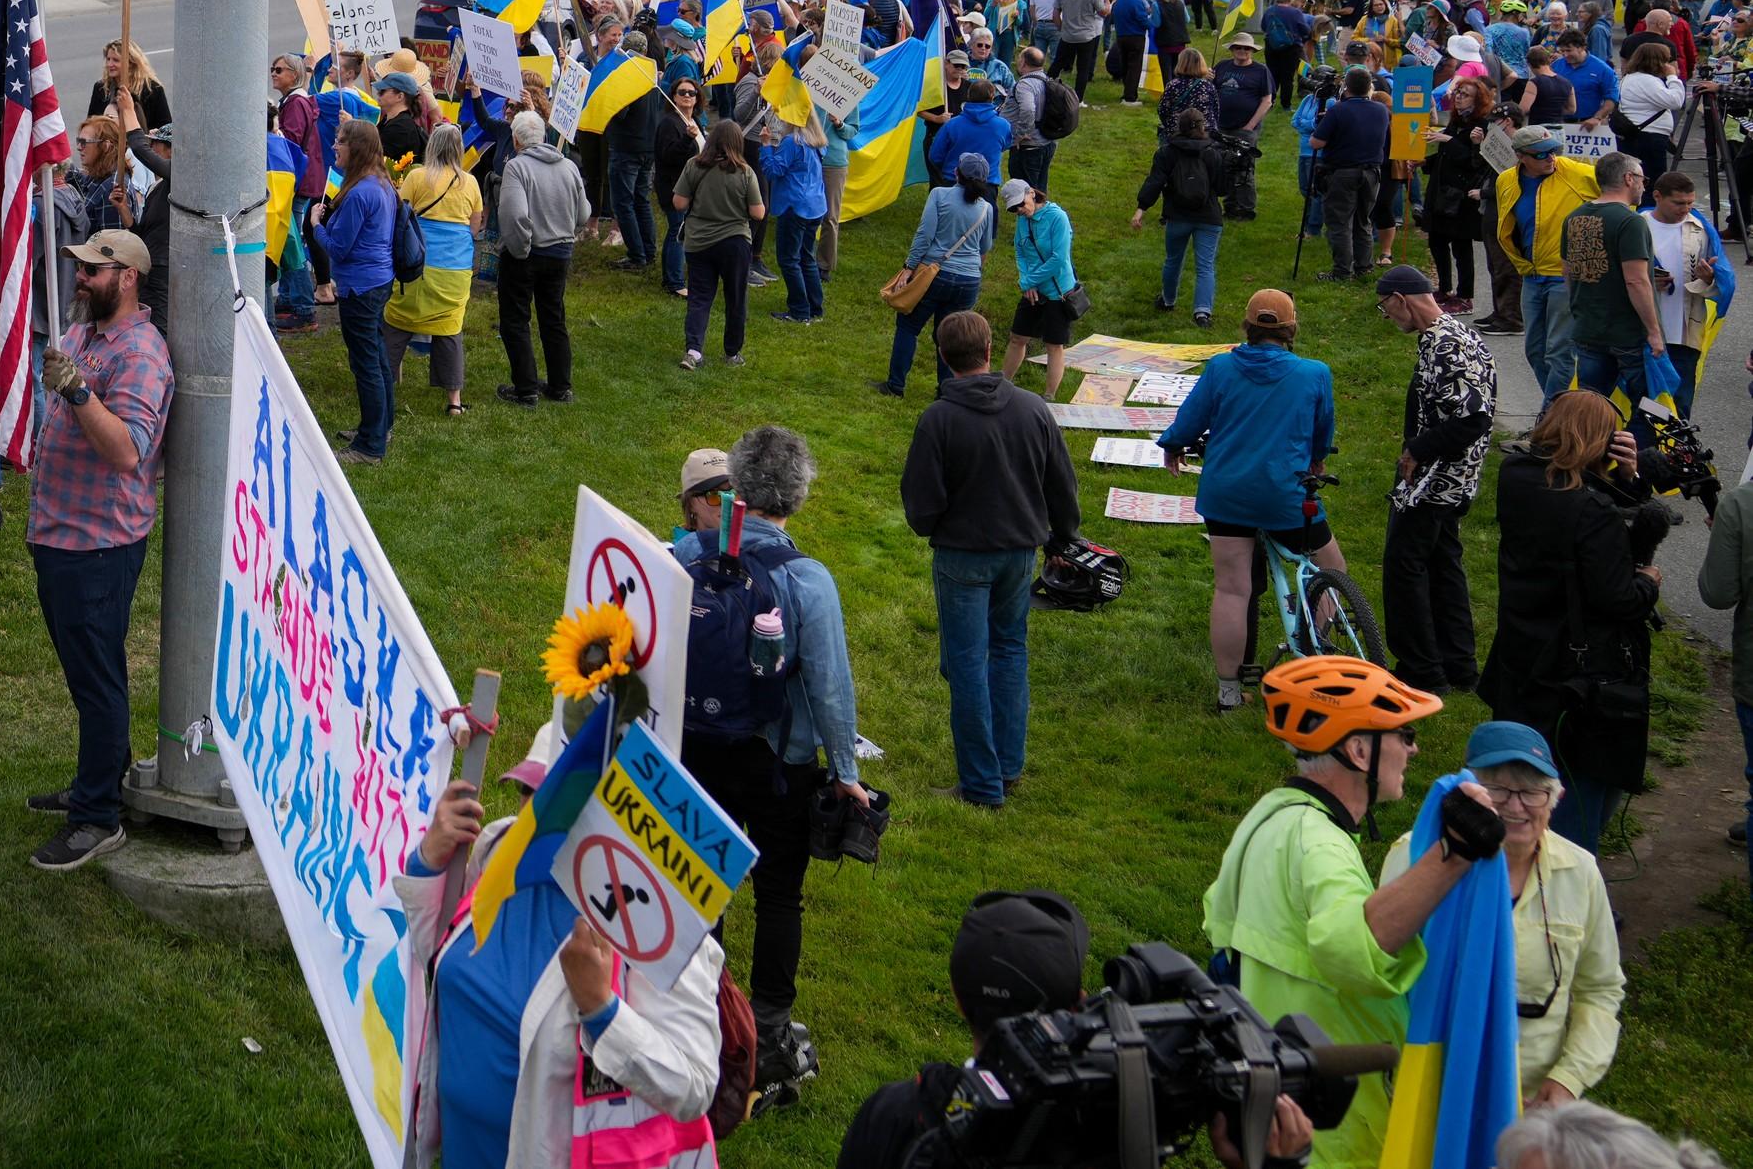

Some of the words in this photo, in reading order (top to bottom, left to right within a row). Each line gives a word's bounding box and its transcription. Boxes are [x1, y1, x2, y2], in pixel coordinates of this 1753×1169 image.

[326, 2, 375, 19] elons
[830, 4, 859, 24] RUSSIA
[335, 23, 358, 40] GET
[365, 18, 390, 34] OUT
[473, 25, 494, 39] TOTAL
[827, 20, 843, 34] OUT
[846, 25, 857, 38] OF
[415, 41, 450, 57] TAND
[472, 40, 499, 57] VICTORY
[824, 34, 859, 56] UKRAINE
[482, 54, 492, 65] TO
[820, 48, 876, 89] ALASKANS
[476, 62, 503, 80] UKRAINE
[800, 71, 847, 109] UKRAINE
[816, 65, 839, 85] STAND
[840, 80, 860, 97] WITH
[1565, 134, 1612, 147] PUTIN
[1568, 145, 1584, 155] IS
[1590, 146, 1601, 156] A
[252, 374, 435, 815] ALASKA
[232, 479, 334, 734] STANDS
[1309, 691, 1341, 706] SMITH
[631, 751, 733, 874] SLAVA
[602, 768, 715, 911] UKRAINI
[982, 985, 1011, 999] POLO
